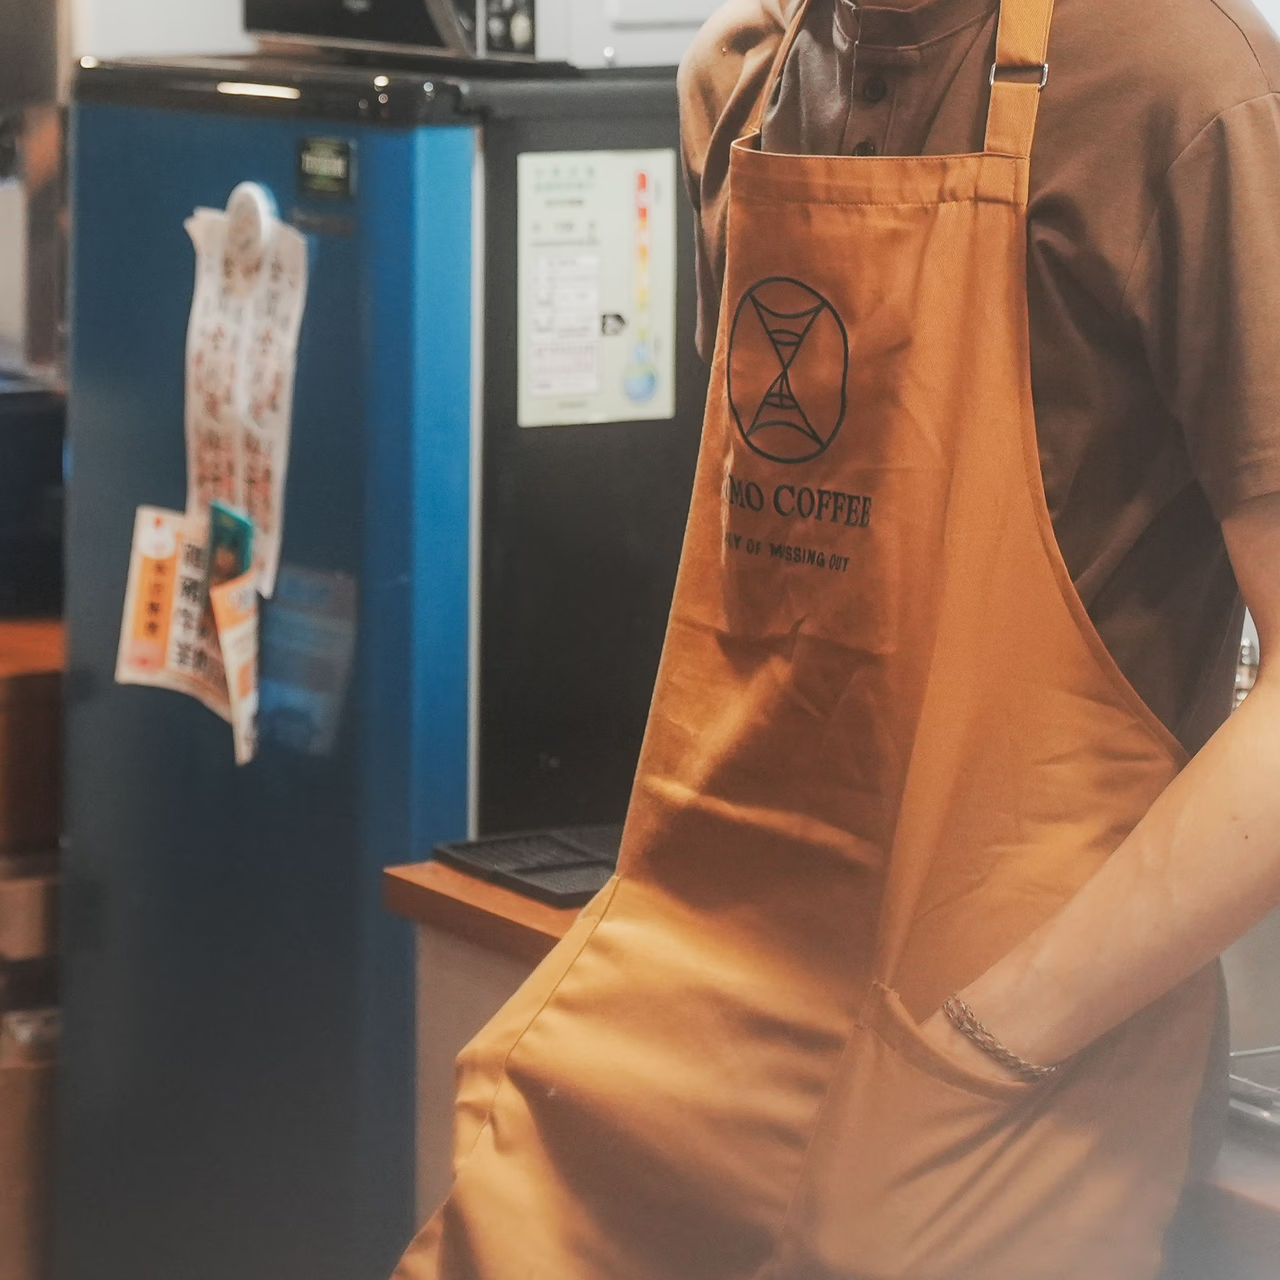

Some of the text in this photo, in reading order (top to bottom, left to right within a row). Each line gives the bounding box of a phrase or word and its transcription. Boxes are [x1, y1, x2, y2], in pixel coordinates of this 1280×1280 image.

[726, 473, 872, 528] MO COFFEE
[746, 537, 761, 556] OF
[769, 542, 826, 569] MISSING
[829, 553, 850, 572] OUT
